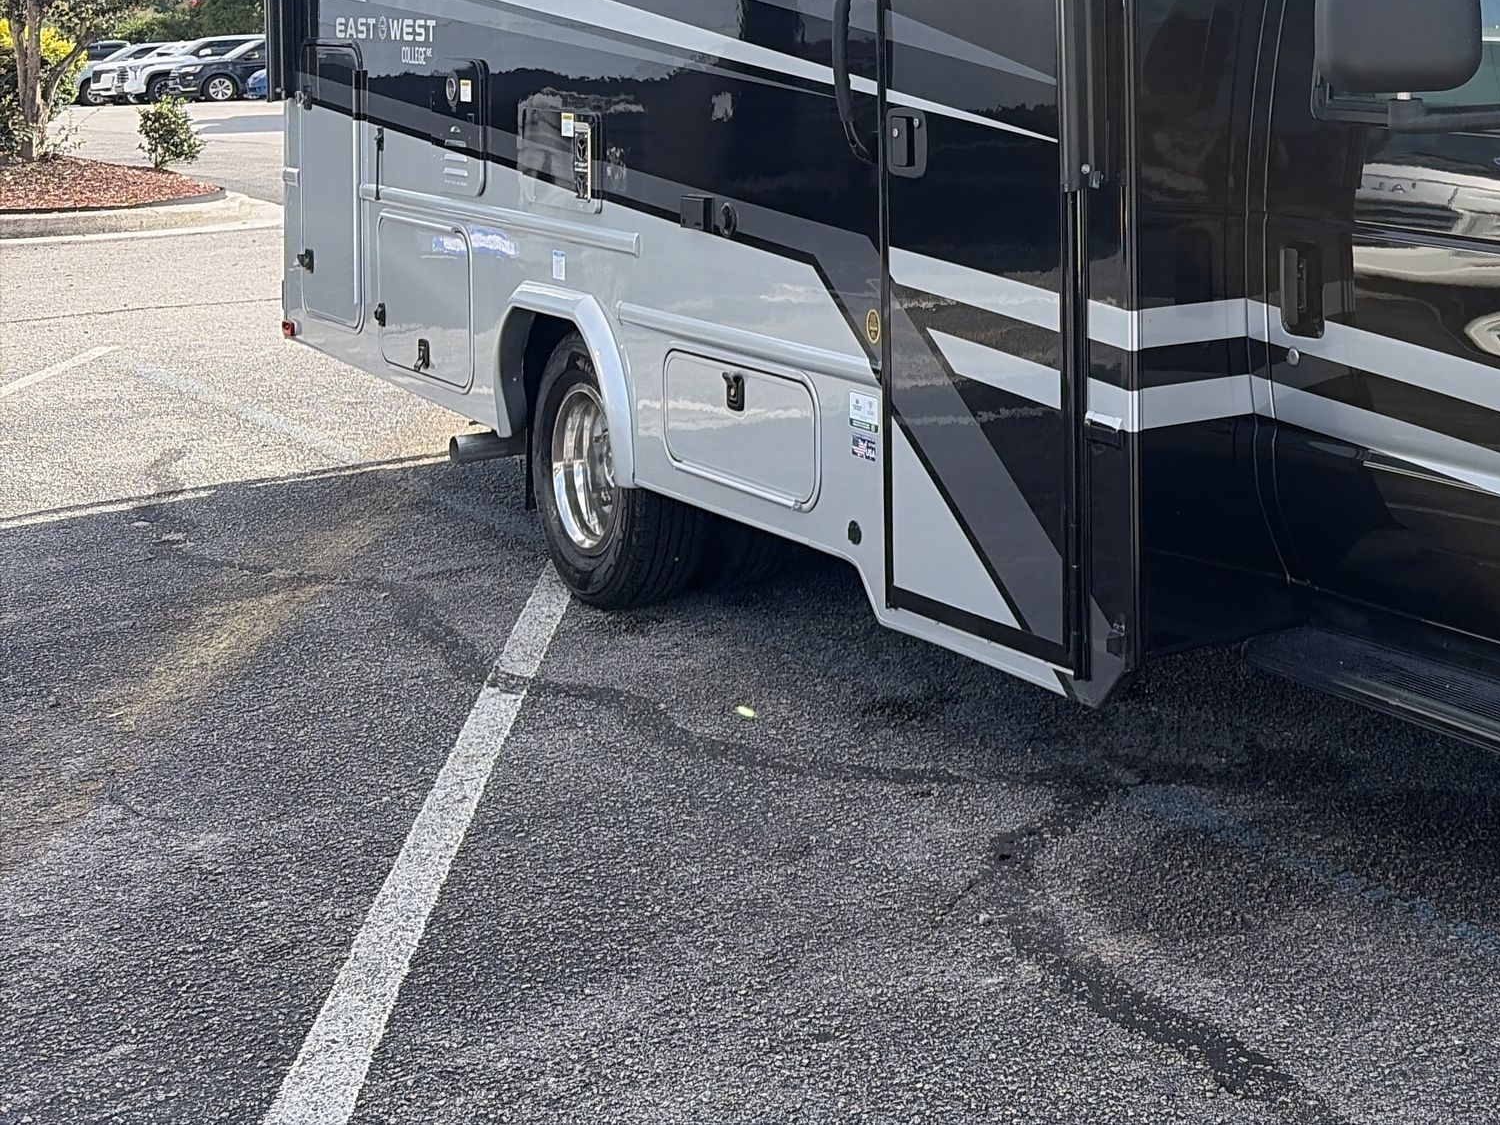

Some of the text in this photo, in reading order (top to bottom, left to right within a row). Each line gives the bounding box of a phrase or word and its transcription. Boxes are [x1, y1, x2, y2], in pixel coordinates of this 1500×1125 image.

[336, 17, 436, 42] EAST WEST
[401, 46, 426, 64] COLLEGE
